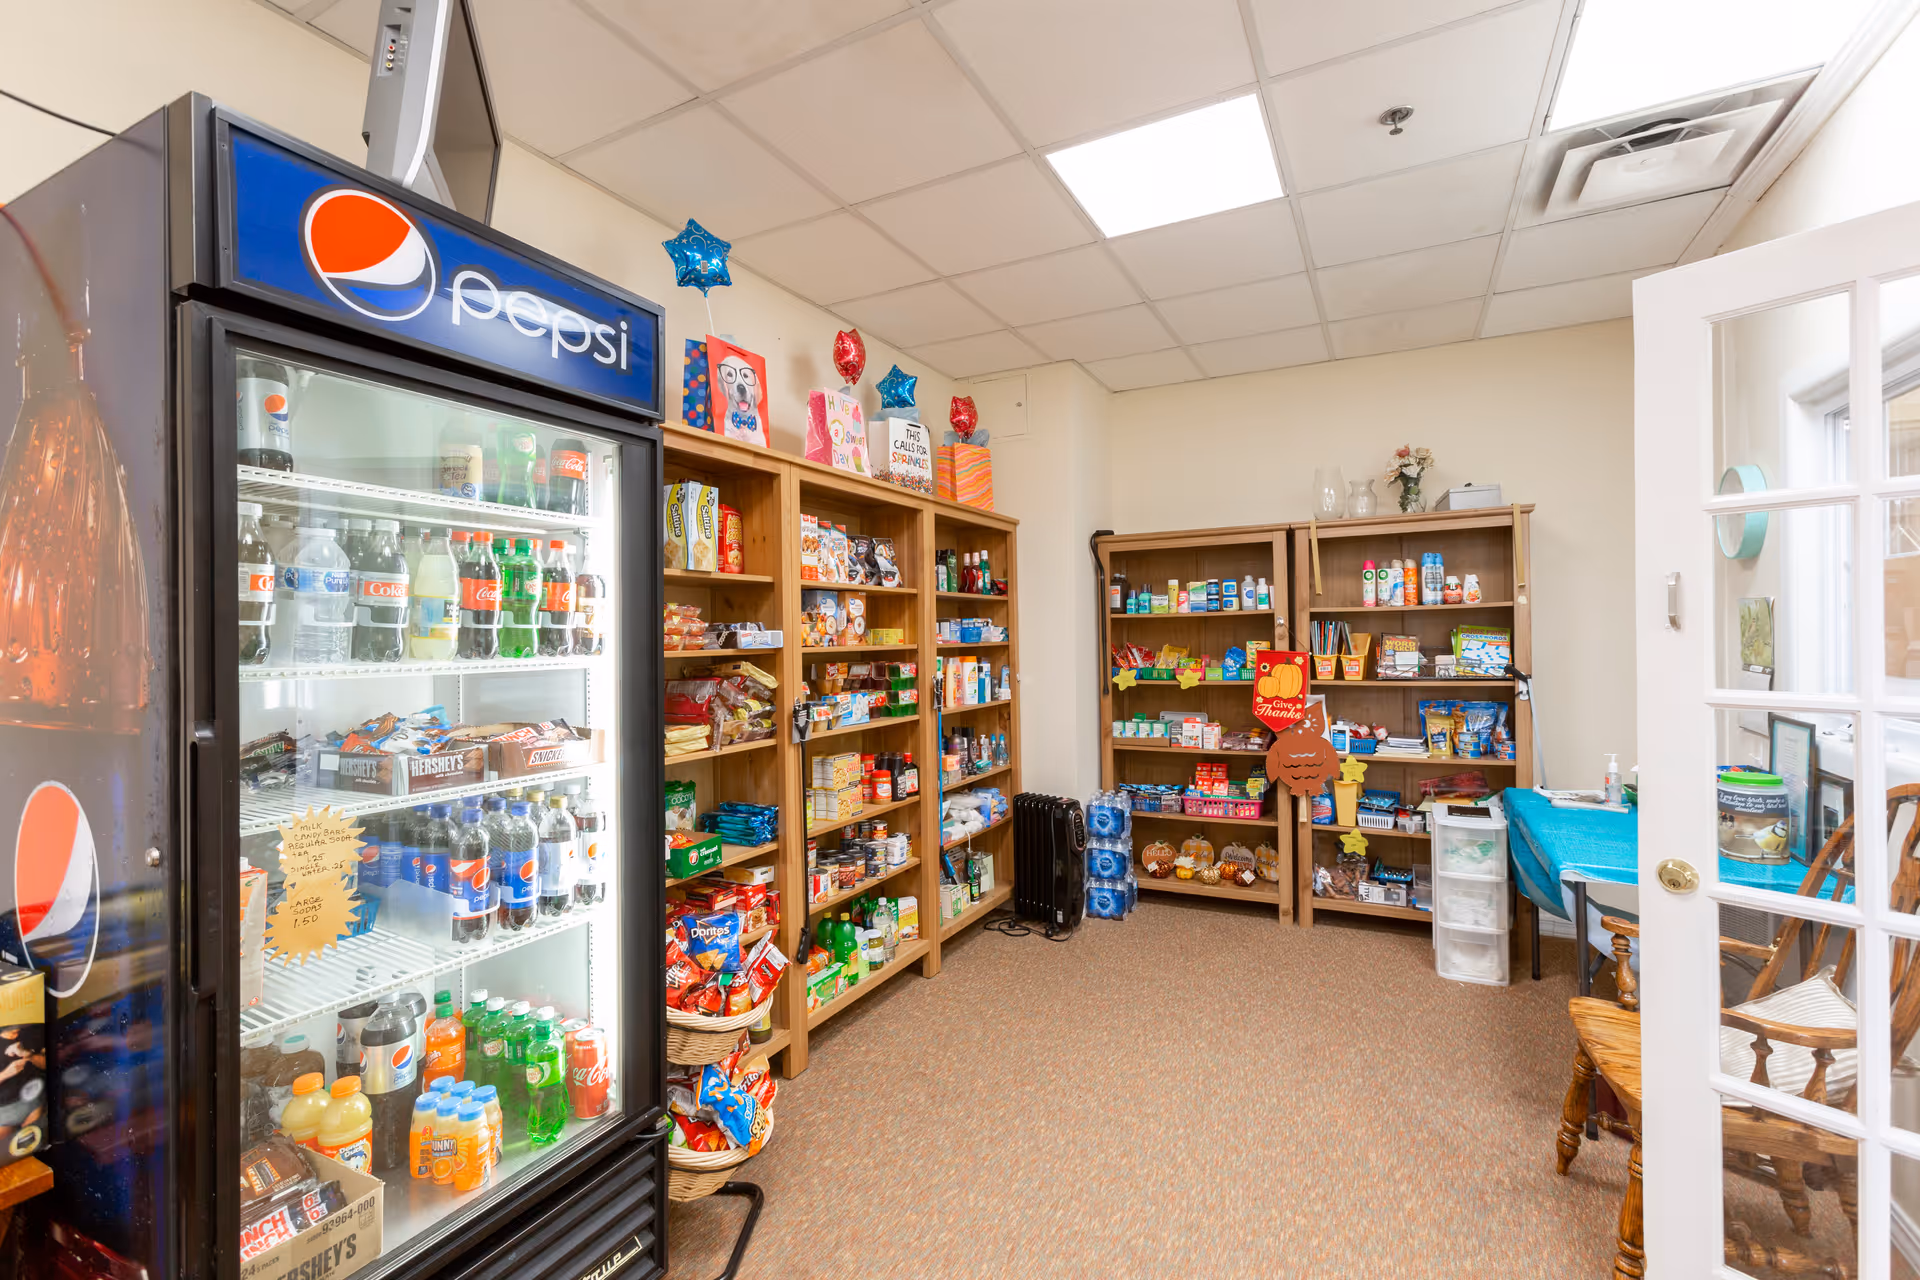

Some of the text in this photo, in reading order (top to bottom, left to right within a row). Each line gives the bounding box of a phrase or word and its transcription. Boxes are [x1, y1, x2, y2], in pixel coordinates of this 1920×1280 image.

[452, 270, 628, 370] pepsi
[894, 440, 928, 455] CALLS FOR
[370, 582, 405, 597] Coke
[1255, 703, 1301, 720] Thanks
[1273, 700, 1293, 709] Give
[531, 748, 565, 765] SNICKE
[411, 754, 464, 777] HERSHEY'S
[294, 828, 346, 842] CANDY BARS
[329, 834, 352, 844] SODA
[1147, 849, 1173, 857] HELLO
[293, 914, 319, 929] 1.50
[691, 926, 730, 939] Doritos
[278, 1233, 357, 1280] RSHEY'S
